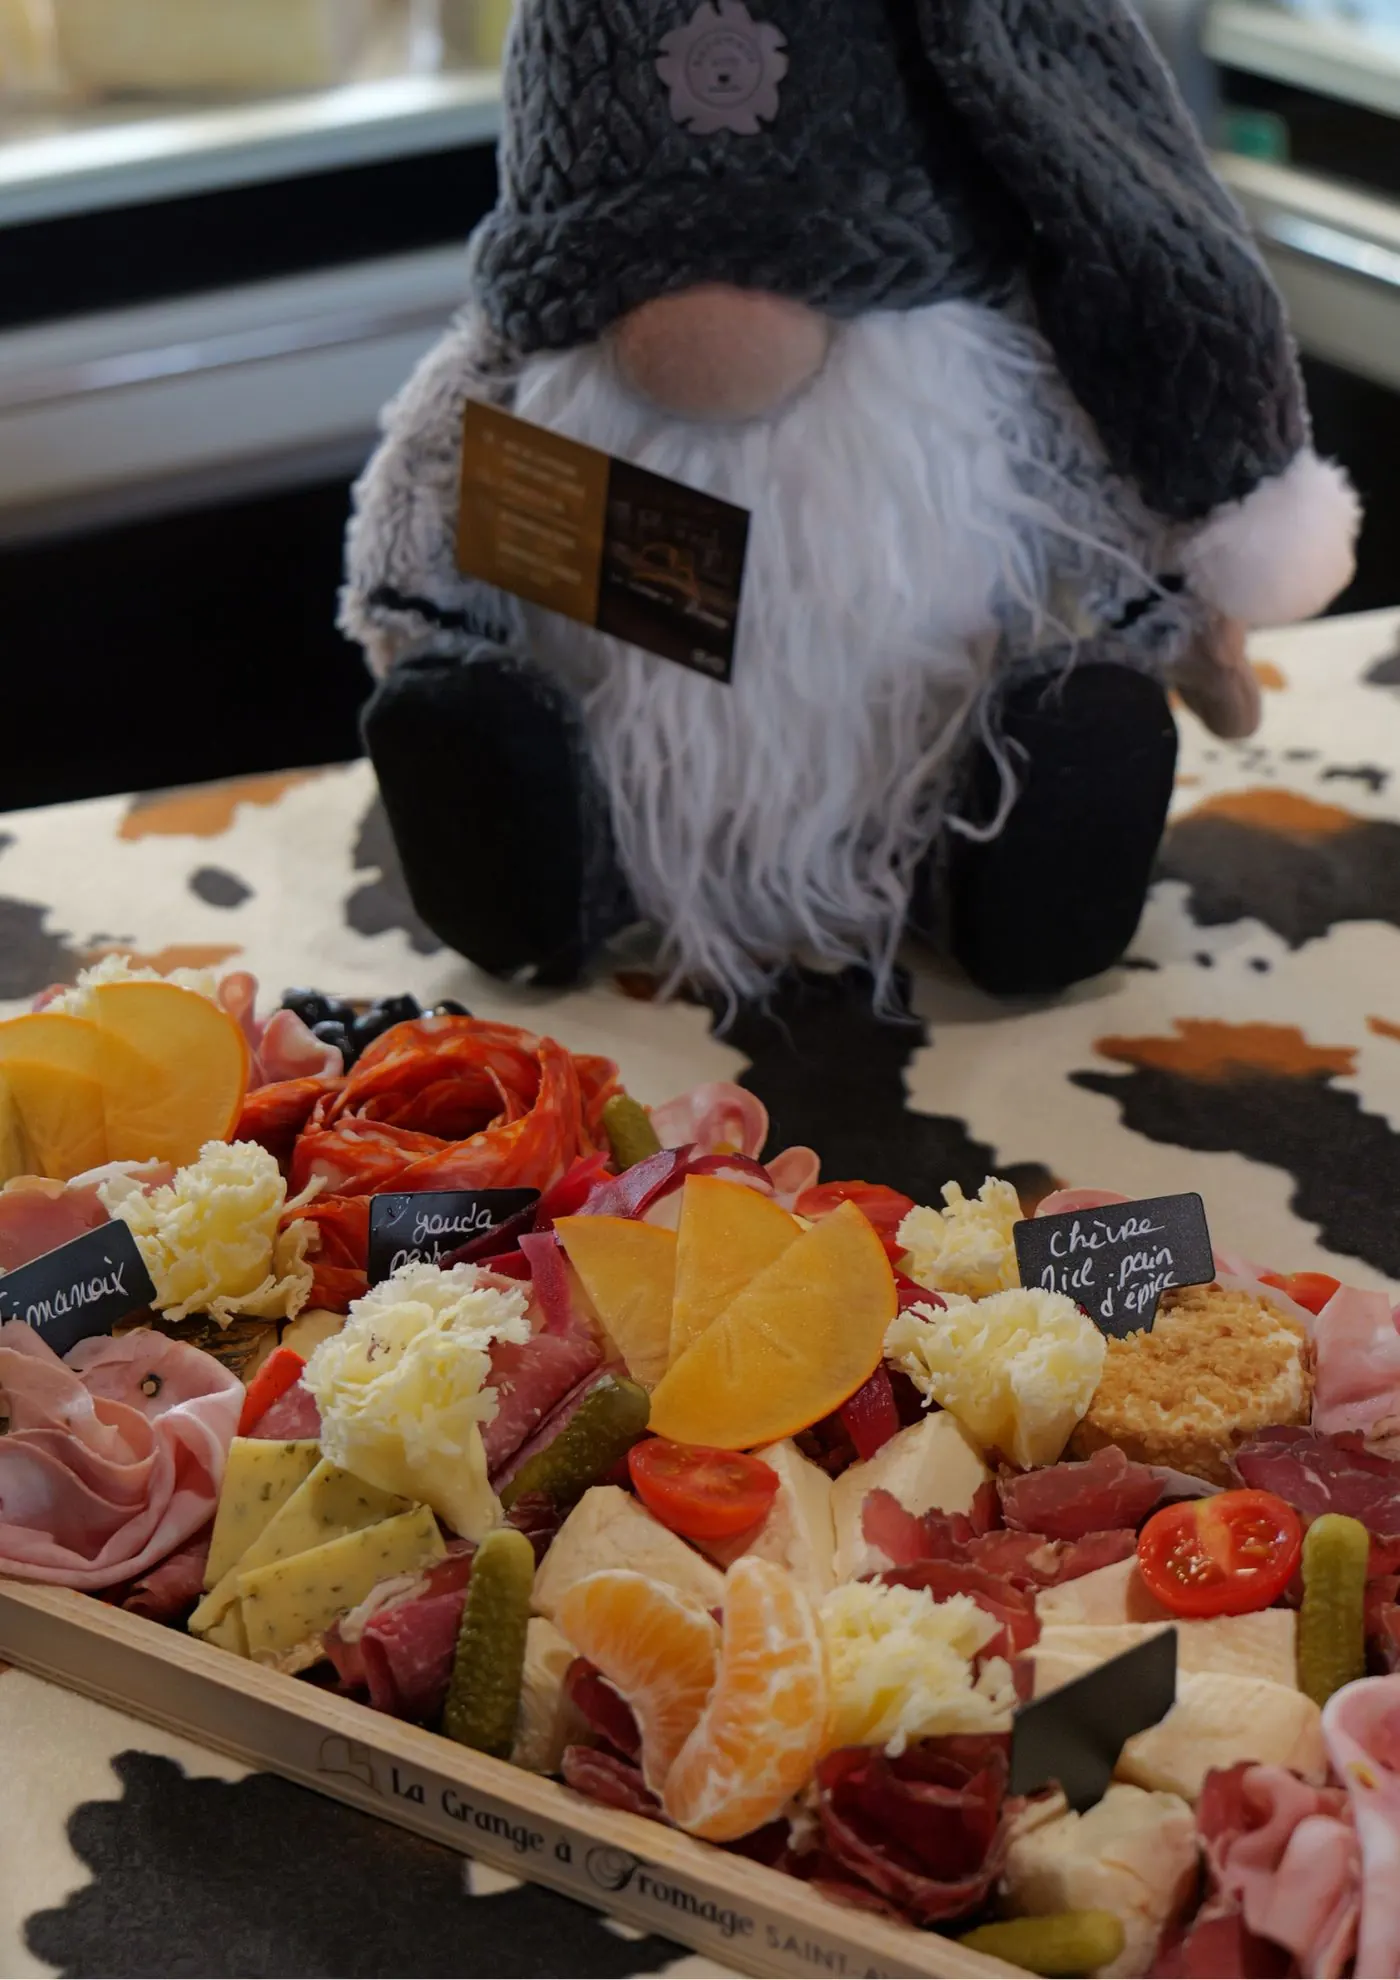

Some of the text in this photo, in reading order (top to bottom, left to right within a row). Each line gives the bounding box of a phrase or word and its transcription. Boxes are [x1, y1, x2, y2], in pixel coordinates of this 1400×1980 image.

[1049, 1217, 1165, 1258] Chèvre
[1119, 1244, 1174, 1288] pain
[390, 1766, 426, 1806] La
[441, 1789, 545, 1855] Grange
[554, 1836, 572, 1864] à
[585, 1845, 756, 1939] Fromage
